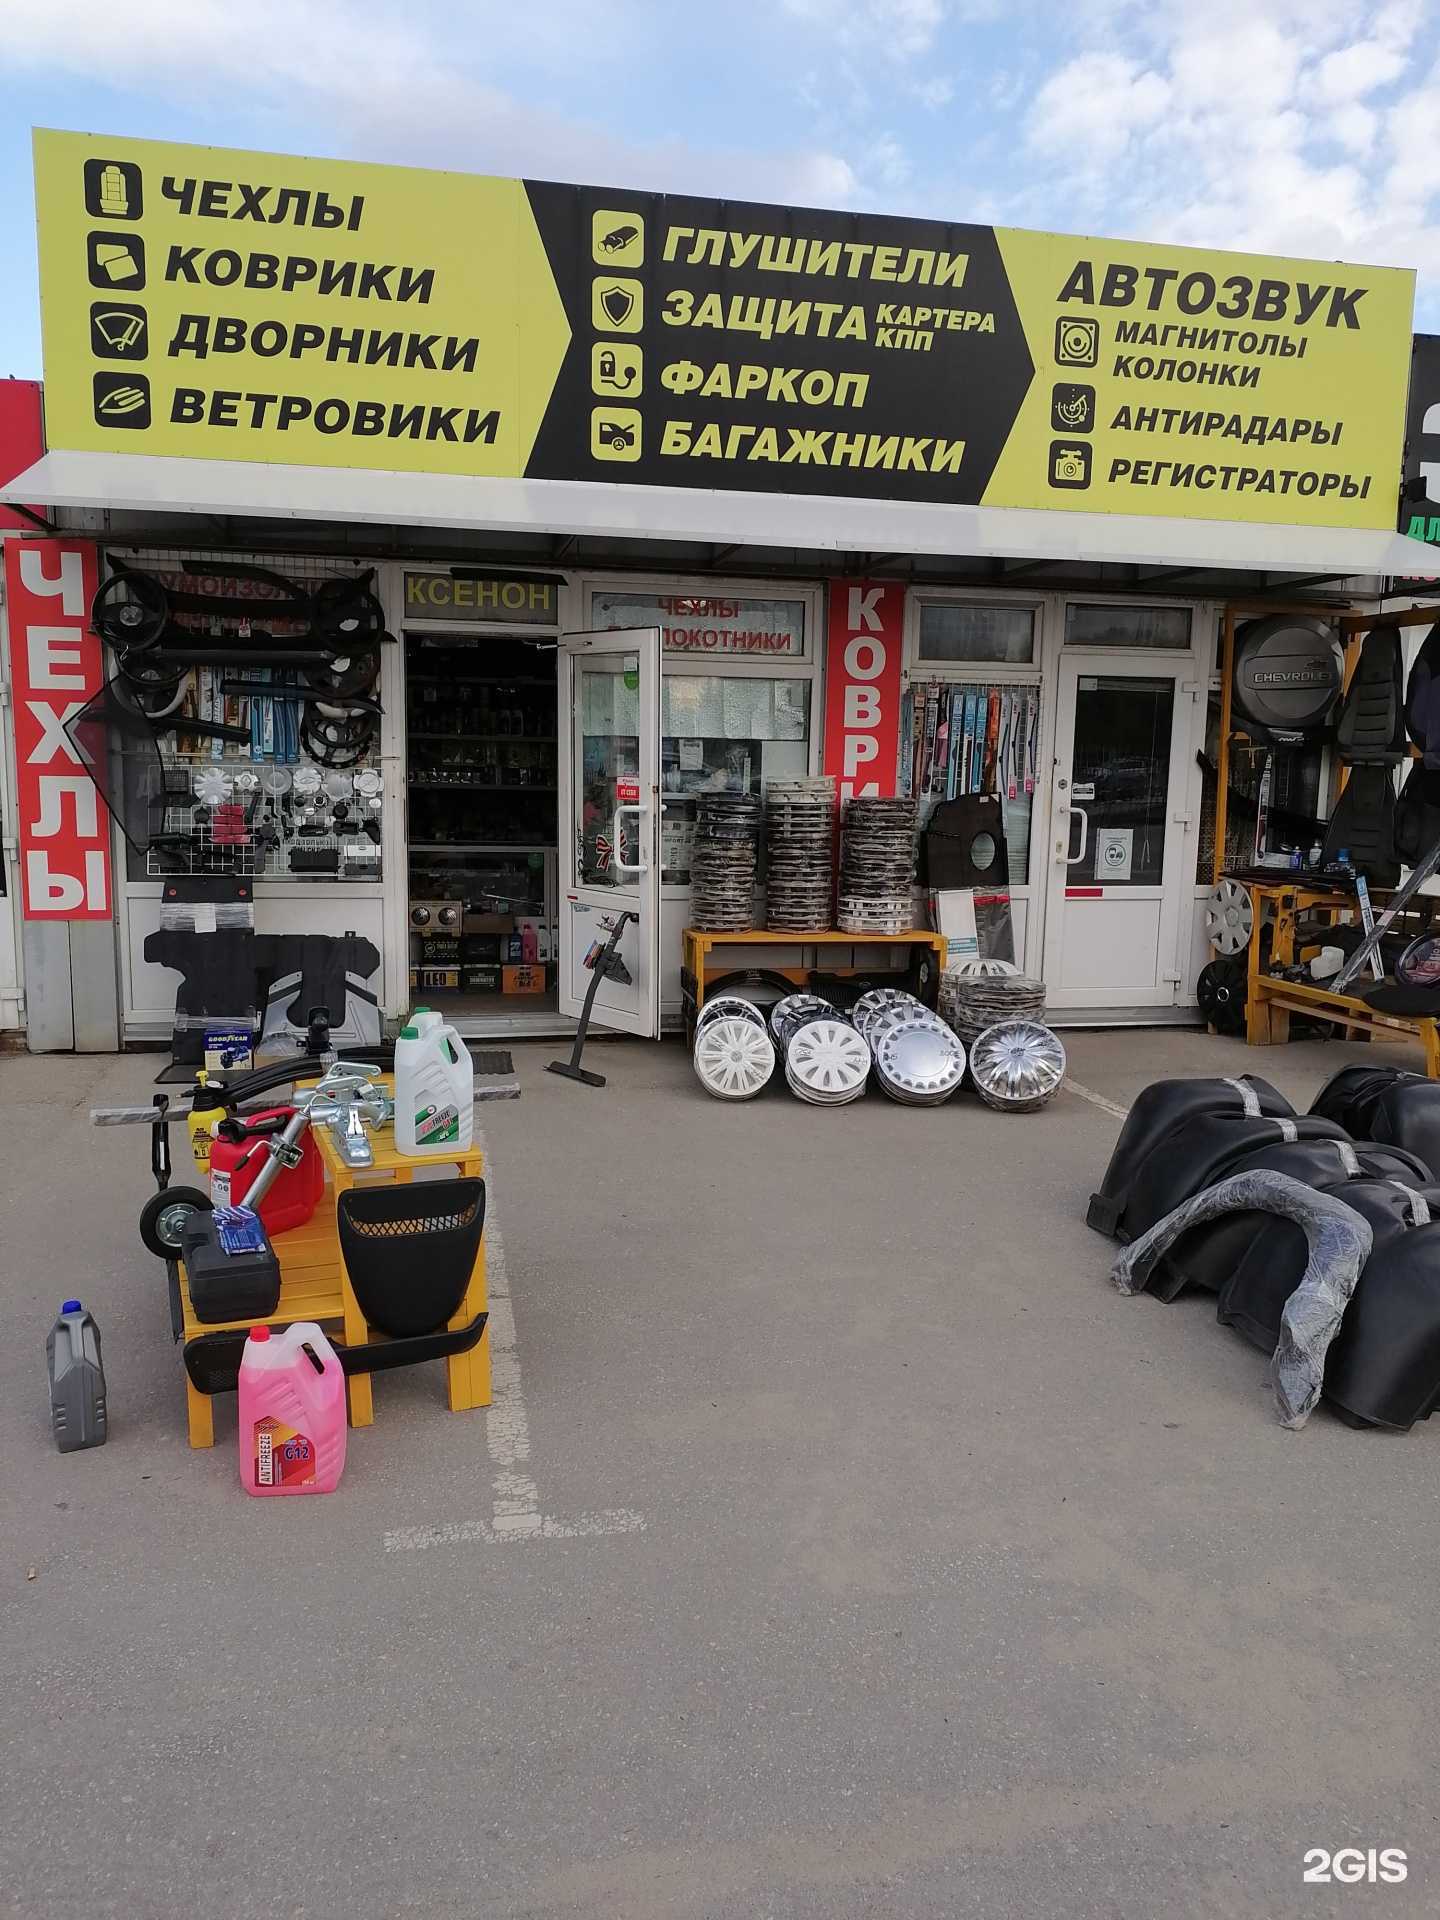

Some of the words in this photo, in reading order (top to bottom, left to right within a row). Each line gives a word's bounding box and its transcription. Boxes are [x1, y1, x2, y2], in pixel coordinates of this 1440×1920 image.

[162, 176, 364, 231] ЧЕХЛЫ
[165, 246, 435, 304] КОВРИКИ
[663, 227, 969, 287] ГЛУШИТЕЛИ
[662, 290, 866, 340] ЗАЩИТА
[1056, 261, 1368, 329] АВТОЗВУК
[875, 328, 933, 351] КПП
[876, 304, 994, 333] КАРТЕРА
[1115, 321, 1307, 358] МАГНИТОЛЫ
[168, 314, 479, 372] ДВОРНИКИ
[661, 361, 869, 407] ФАРКОП
[1113, 355, 1260, 387] КОЛОНКИ
[170, 388, 500, 444] ВЕТРОВИКИ
[1110, 406, 1343, 445] АНТИРАДАРЫ
[660, 421, 965, 473] БАГАЖНИКИ
[1109, 459, 1371, 498] РЕГИСТРАТОРЫ
[407, 576, 550, 610] КСЕНОН
[1254, 672, 1334, 683] CHEVROLE
[19, 550, 106, 912] ЧЕХЛЫ
[285, 1446, 309, 1460] G12
